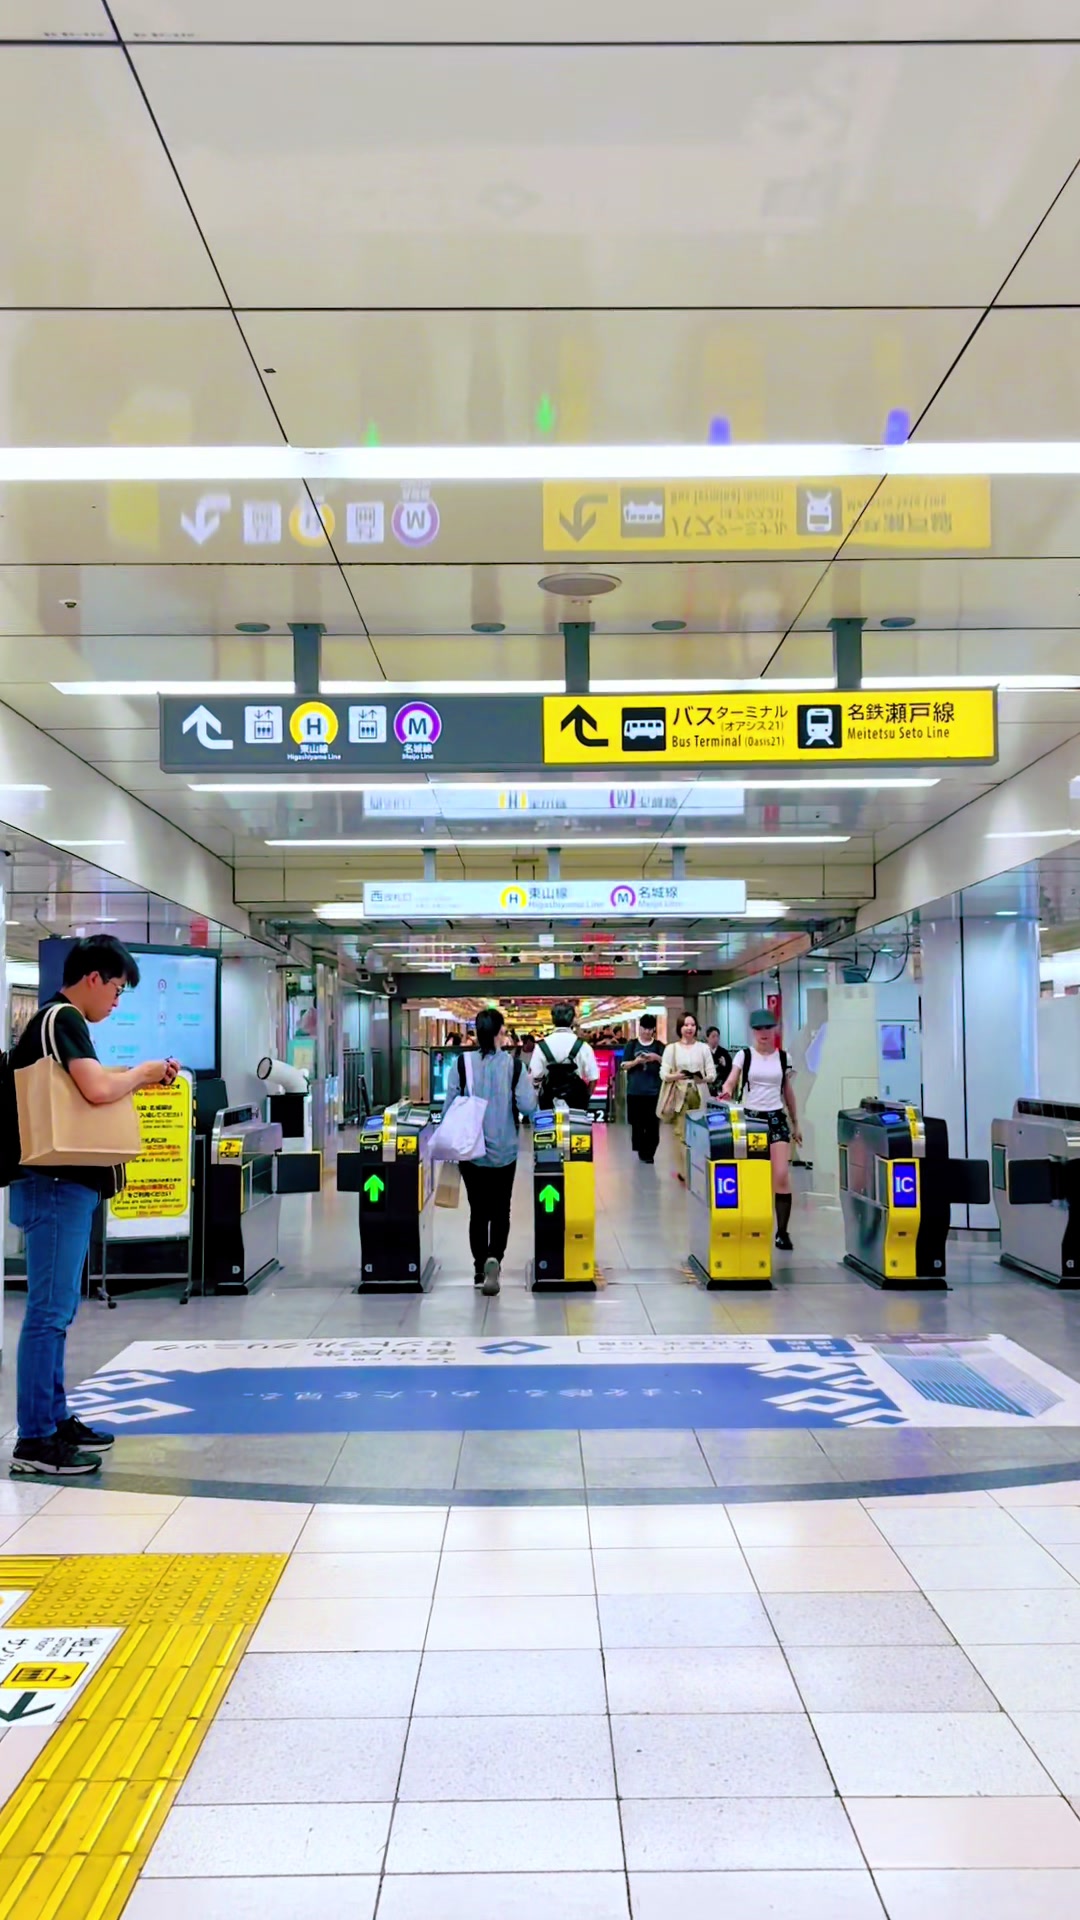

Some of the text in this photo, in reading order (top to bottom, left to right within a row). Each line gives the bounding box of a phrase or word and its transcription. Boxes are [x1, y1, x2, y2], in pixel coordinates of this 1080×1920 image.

[673, 705, 788, 726] バスターミナル
[848, 702, 954, 723] 名鉄瀬戸線
[306, 718, 321, 735] H
[408, 718, 427, 735] M
[848, 726, 950, 740] Meitetsu Seto Line
[672, 735, 691, 747] Bus
[694, 734, 742, 748] Terminal
[300, 744, 328, 754] 東山線
[404, 743, 433, 754] 名城線
[509, 893, 518, 904] H
[529, 887, 567, 899] 東山線
[618, 893, 629, 903] M
[639, 887, 678, 898] 名城線
[717, 1178, 736, 1194] IC
[895, 1177, 914, 1193] IC
